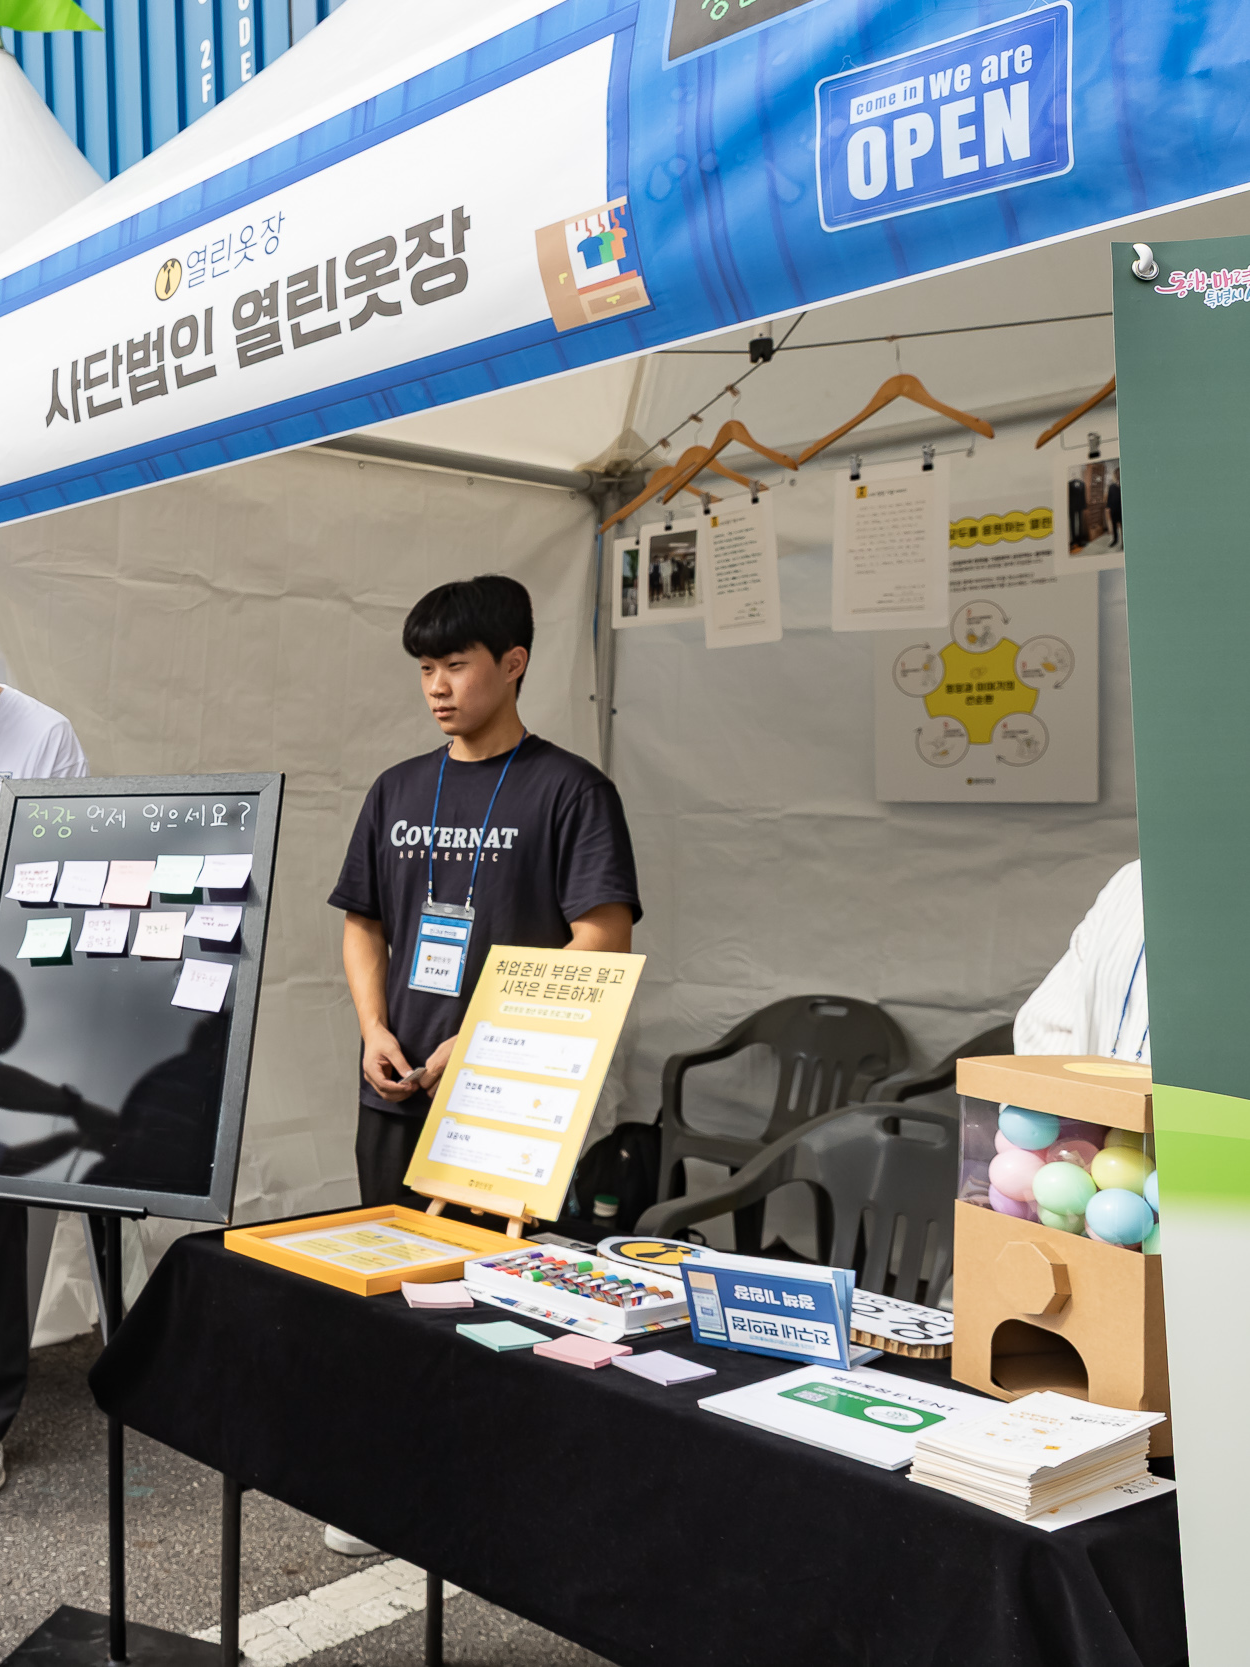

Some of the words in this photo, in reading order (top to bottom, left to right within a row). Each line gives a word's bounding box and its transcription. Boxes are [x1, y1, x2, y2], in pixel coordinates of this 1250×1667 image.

[199, 39, 212, 103] 2F
[856, 92, 897, 116] come
[903, 86, 917, 102] in
[929, 64, 972, 100] we
[981, 44, 1032, 84] are
[847, 80, 1031, 200] OPEN
[187, 211, 286, 289] 열린옷장
[1206, 288, 1243, 308] 특별시
[45, 306, 217, 428] 사단법인
[232, 205, 471, 369] 열린옷장
[28, 802, 76, 838] 정장
[86, 804, 127, 833] 언제
[142, 801, 252, 833] 입으세요?
[390, 819, 519, 850] COVERNAT
[398, 849, 499, 863] AUTHENTIC
[424, 966, 450, 977] STAFF
[495, 960, 548, 978] 취업준비
[551, 964, 592, 982] 부담은
[596, 967, 625, 984] 덜고
[500, 980, 540, 998] 시작은
[543, 983, 604, 1003] 든든하게!
[734, 1284, 781, 1305] 기입장
[782, 1291, 816, 1311] 정책
[731, 1315, 779, 1338] 편의점
[780, 1323, 831, 1346] 진구네
[892, 1391, 961, 1414] EVENT
